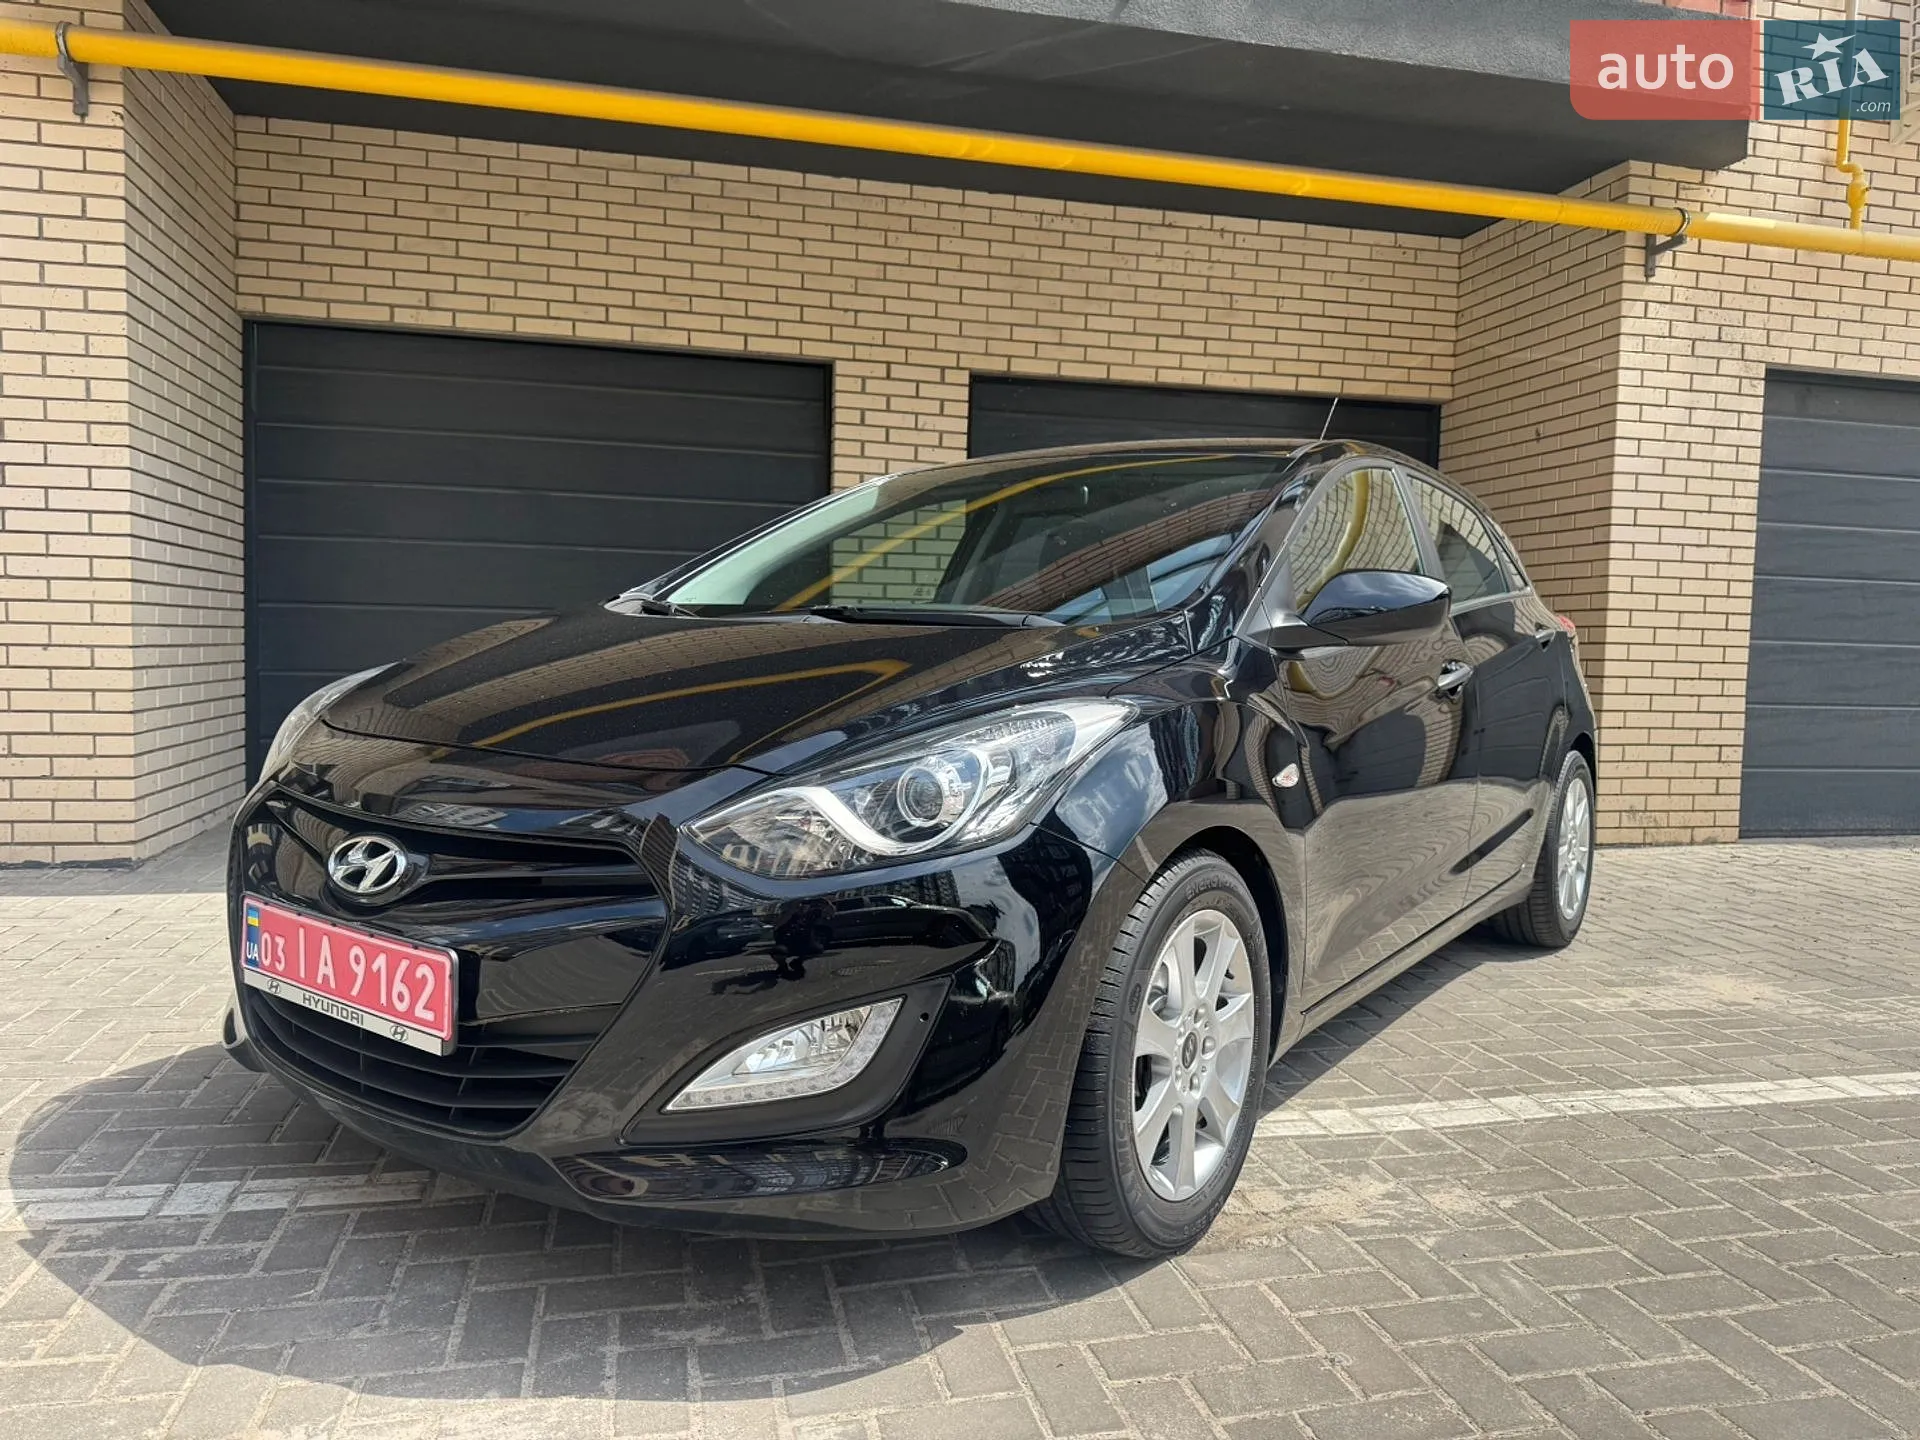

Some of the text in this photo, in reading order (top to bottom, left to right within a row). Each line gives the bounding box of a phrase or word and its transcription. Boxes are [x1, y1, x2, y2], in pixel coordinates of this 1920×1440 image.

[246, 942, 259, 961] UA
[261, 932, 286, 971] 03
[349, 945, 436, 1022] 9162
[302, 993, 364, 1026] HYUNDAI
